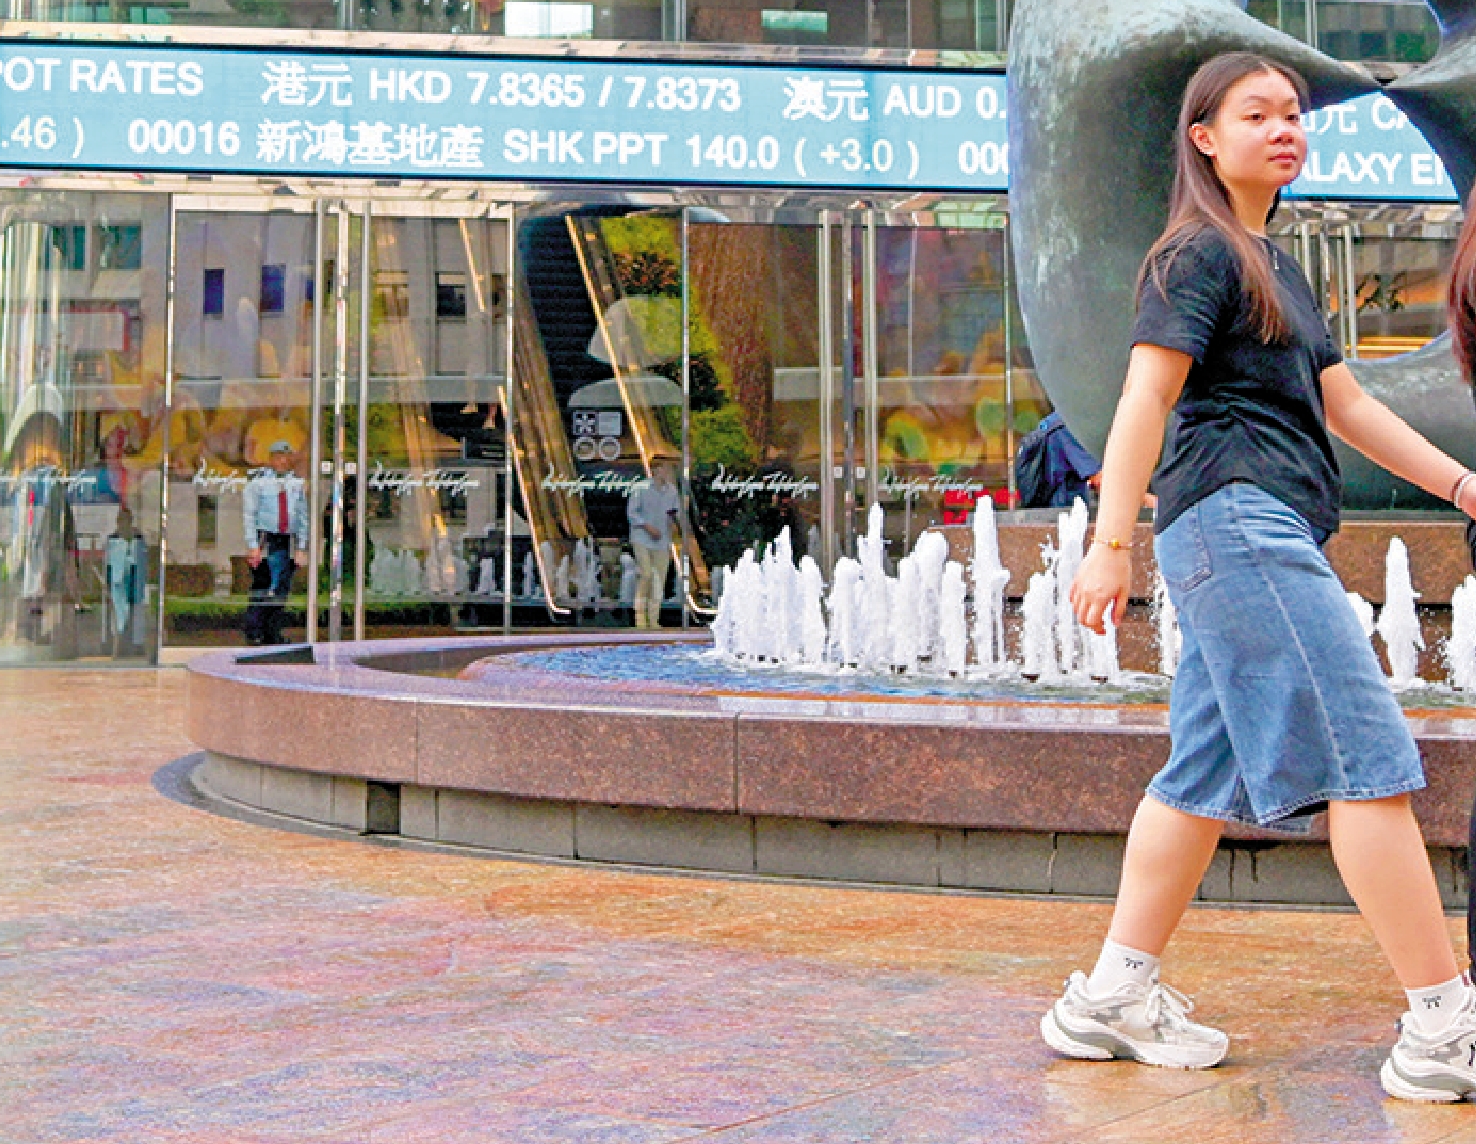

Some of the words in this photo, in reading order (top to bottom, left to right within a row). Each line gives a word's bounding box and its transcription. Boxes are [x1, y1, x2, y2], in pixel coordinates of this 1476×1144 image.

[70, 60, 203, 95] RATES
[262, 62, 352, 105] 港元
[371, 69, 450, 103] HKD
[467, 73, 584, 107] 7.8365
[625, 77, 740, 111] 7.8373
[784, 77, 868, 120] 澳元
[885, 86, 961, 115] AUD
[1300, 104, 1360, 136] 元
[129, 120, 239, 155] 00016
[257, 120, 483, 167] 新鴻基地產
[505, 130, 582, 162] SHK
[595, 132, 667, 164] PPT
[687, 135, 778, 169] 140.0
[821, 139, 891, 171] +3.0
